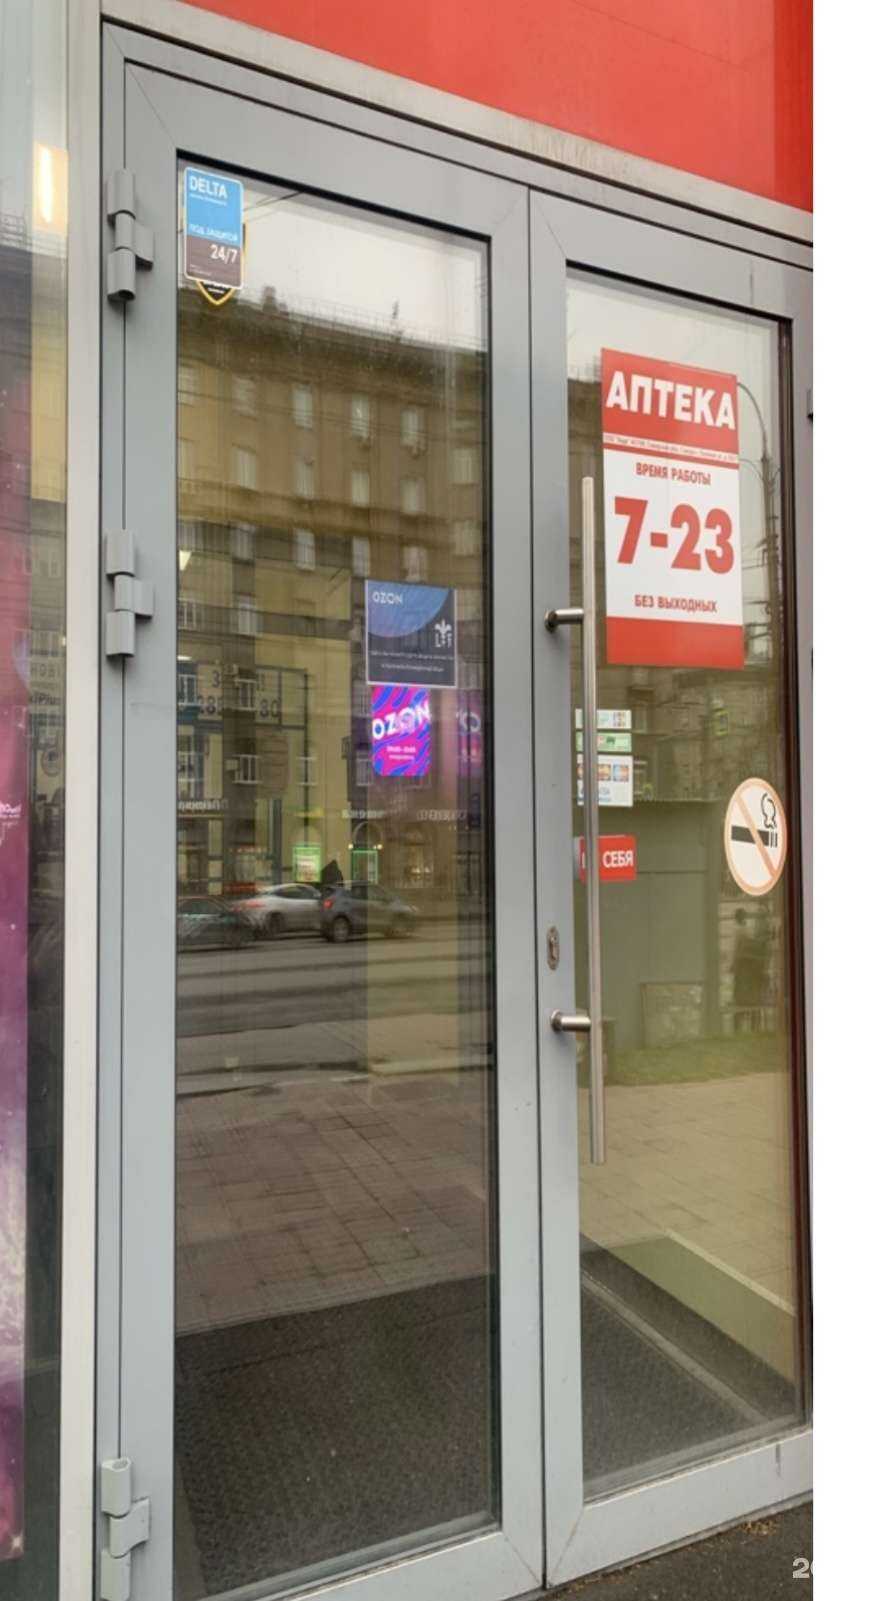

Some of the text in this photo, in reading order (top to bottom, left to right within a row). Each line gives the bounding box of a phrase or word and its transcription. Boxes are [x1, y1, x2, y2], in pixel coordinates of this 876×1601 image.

[189, 175, 228, 200] DELTA
[210, 244, 238, 265] 24/7
[605, 370, 736, 430] АПТЕКА
[635, 462, 711, 486] ВРЕМЯ РАБОТЫ
[614, 496, 735, 574] 7-23
[372, 591, 402, 605] OZON
[634, 594, 718, 613] БЕЗ ВЫХОДНЫХ
[371, 700, 431, 740] OZON
[602, 850, 634, 868] СЕБЯ
